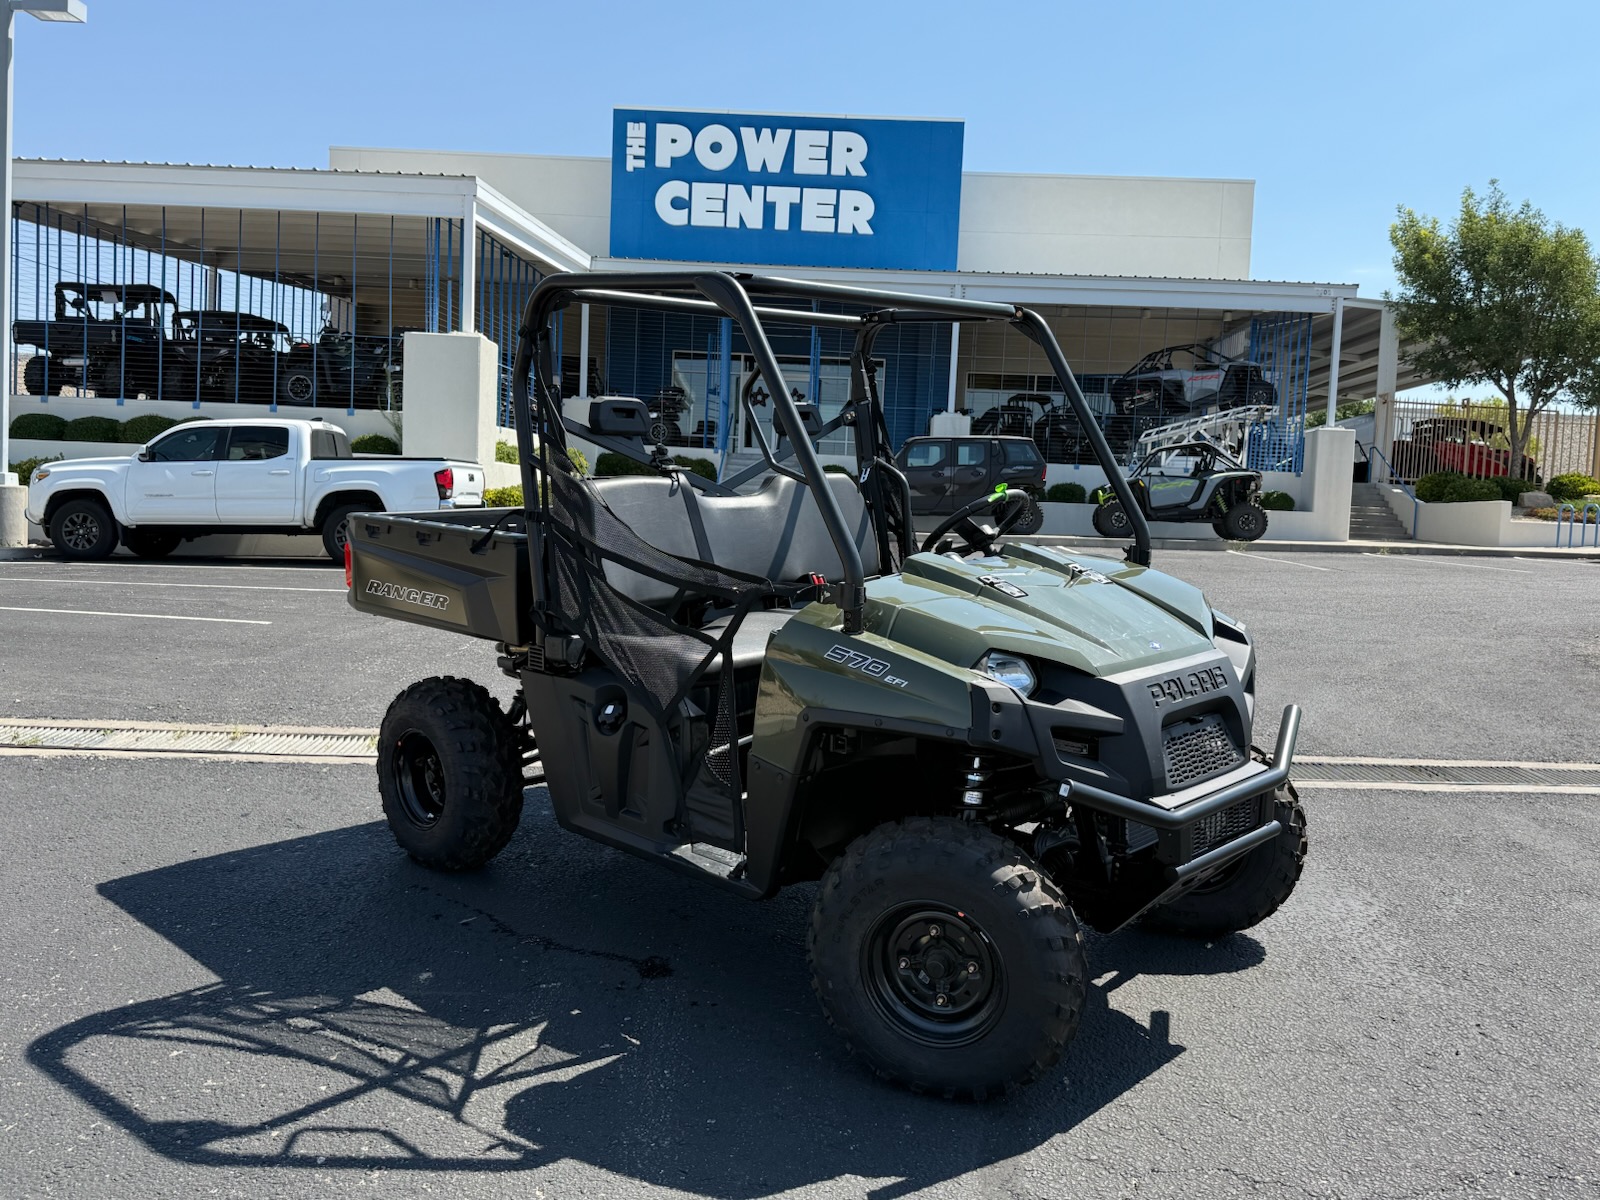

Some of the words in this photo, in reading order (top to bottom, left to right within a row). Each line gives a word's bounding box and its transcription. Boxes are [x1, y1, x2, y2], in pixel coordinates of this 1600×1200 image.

[626, 121, 646, 172] THE
[655, 122, 868, 176] POWER
[654, 179, 875, 235] CENTER
[366, 579, 449, 609] RANGER
[824, 644, 891, 677] 570
[884, 675, 909, 688] EFI
[1147, 666, 1228, 708] POLARIS
